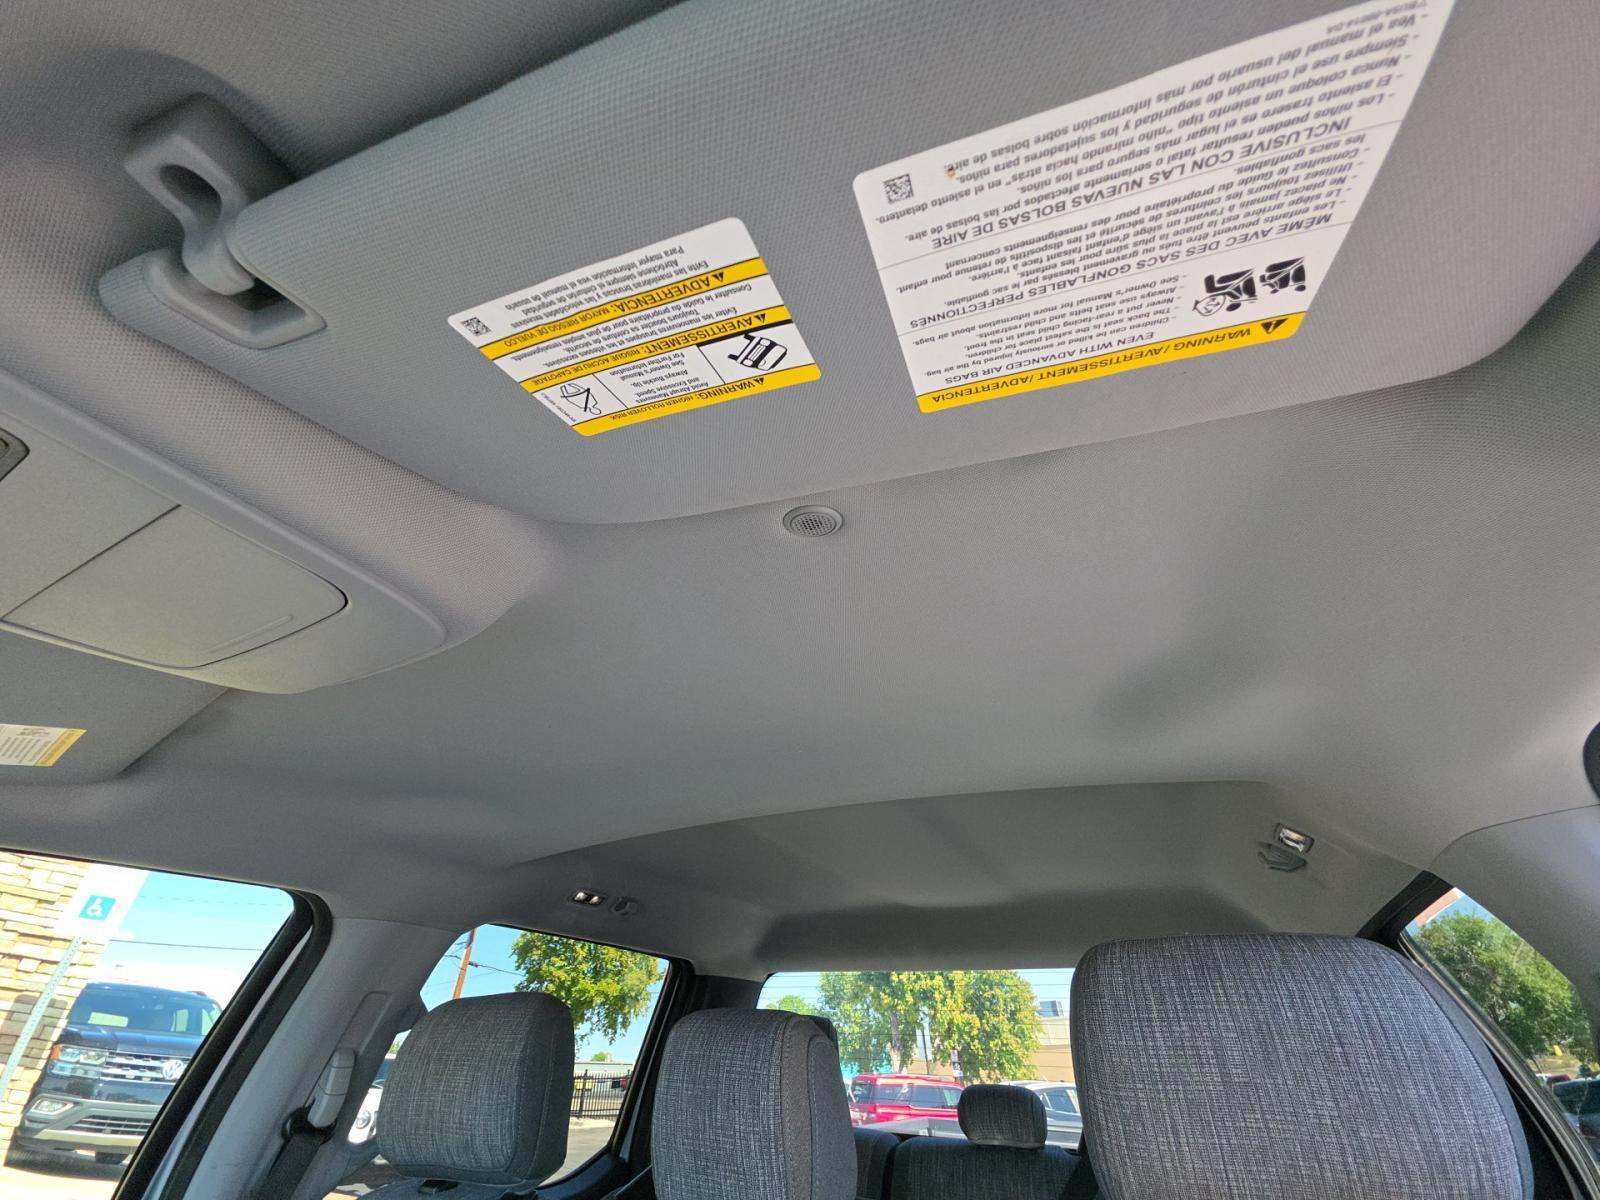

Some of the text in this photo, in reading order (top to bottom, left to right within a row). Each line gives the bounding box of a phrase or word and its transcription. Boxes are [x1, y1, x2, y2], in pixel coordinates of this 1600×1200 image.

[1367, 22, 1384, 37] el
[1387, 13, 1416, 30] Vea
[1304, 28, 1365, 57] manual
[1276, 47, 1302, 66] del
[1350, 54, 1401, 76] Nunca
[1217, 55, 1274, 82] usuario
[1189, 73, 1215, 92] por
[1287, 69, 1347, 95] coloque
[1264, 88, 1284, 101] un
[1356, 92, 1385, 108] Los
[1208, 94, 1261, 119] asiento
[1177, 113, 1204, 129] tipo
[1256, 111, 1310, 136] pueden
[1033, 126, 1069, 145] sobre
[1199, 129, 1254, 152] resultar
[990, 138, 1030, 158] bolsas
[1081, 136, 1134, 160] mirando
[1166, 146, 1197, 165] fatal
[1234, 133, 1366, 175] les sacs gonflables.
[972, 152, 988, 164] de
[1045, 154, 1079, 172] hacia
[1155, 157, 1164, 166] o
[931, 116, 1351, 249] INCLUSIVE CON LAS NUEVAS BOLSAS DE AIRE
[1083, 160, 1152, 189] seriamente
[974, 184, 985, 196] el
[987, 178, 1002, 190] en
[930, 188, 971, 207] asiento
[1023, 183, 1080, 207] afectados
[875, 202, 928, 224] delantero.
[982, 207, 1000, 219] las
[1001, 199, 1021, 213] por
[930, 224, 943, 235] de
[945, 213, 981, 230] bolsas
[905, 229, 928, 241] aire.
[1224, 226, 1273, 247] AVEC
[1185, 239, 1220, 257] DES
[1135, 250, 1181, 270] SACS
[1027, 263, 1131, 297] GONFLABLES
[503, 273, 710, 347] ADVERTENCIA: MAYOR RIESGO DE VUELCO
[912, 274, 1179, 346] See Owner's Manual for more information about air bags.
[1125, 302, 1143, 314] put
[1146, 296, 1174, 308] Never
[976, 286, 1177, 338] Always use seat belts and child restraints.
[1062, 310, 1115, 328] rear-facing
[1127, 312, 1150, 322] back
[1152, 307, 1170, 316] The
[1037, 323, 1061, 334] child
[1074, 326, 1090, 334] the
[1103, 318, 1124, 328] seat
[1109, 326, 1127, 335] can
[1128, 316, 1169, 330] Children
[989, 337, 1003, 345] the
[1016, 329, 1036, 339] seat
[1018, 335, 1042, 347] place
[1044, 329, 1073, 341] safest
[1068, 334, 1093, 345] killed
[1173, 327, 1251, 351] WARNING
[531, 316, 753, 385] AVERTISSEMENT: RISQUE ACCRU DE CAPOTAGE
[964, 341, 987, 351] front.
[965, 346, 1002, 358] children.
[1014, 343, 1054, 356] seriously
[944, 331, 1154, 383] EVEN WITH ADVANCED AIR BAGS
[983, 352, 1013, 364] injured
[610, 380, 756, 420] WARNING: HIGHER ROLLOVER RISK
